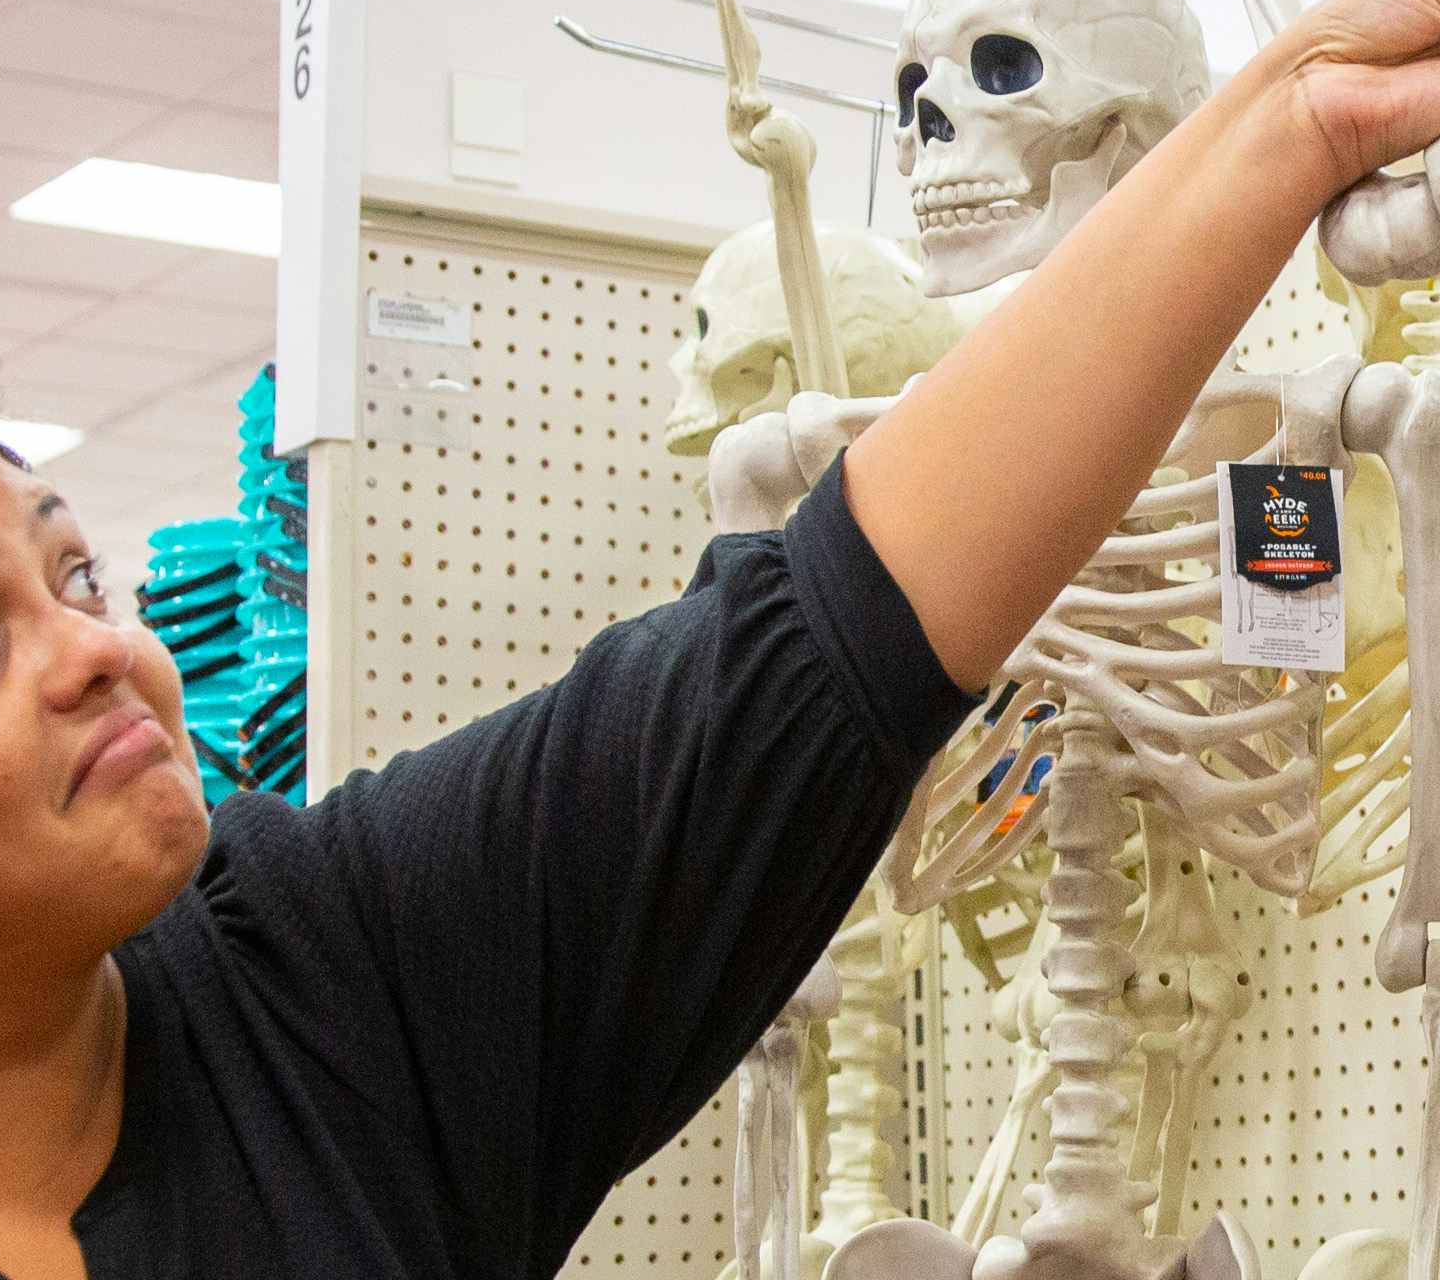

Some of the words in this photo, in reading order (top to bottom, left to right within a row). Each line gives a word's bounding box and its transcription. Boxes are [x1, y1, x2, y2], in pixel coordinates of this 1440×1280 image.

[1263, 497, 1308, 513] HYDE
[1272, 514, 1301, 525] EEK!
[1266, 543, 1311, 551] POSABLE
